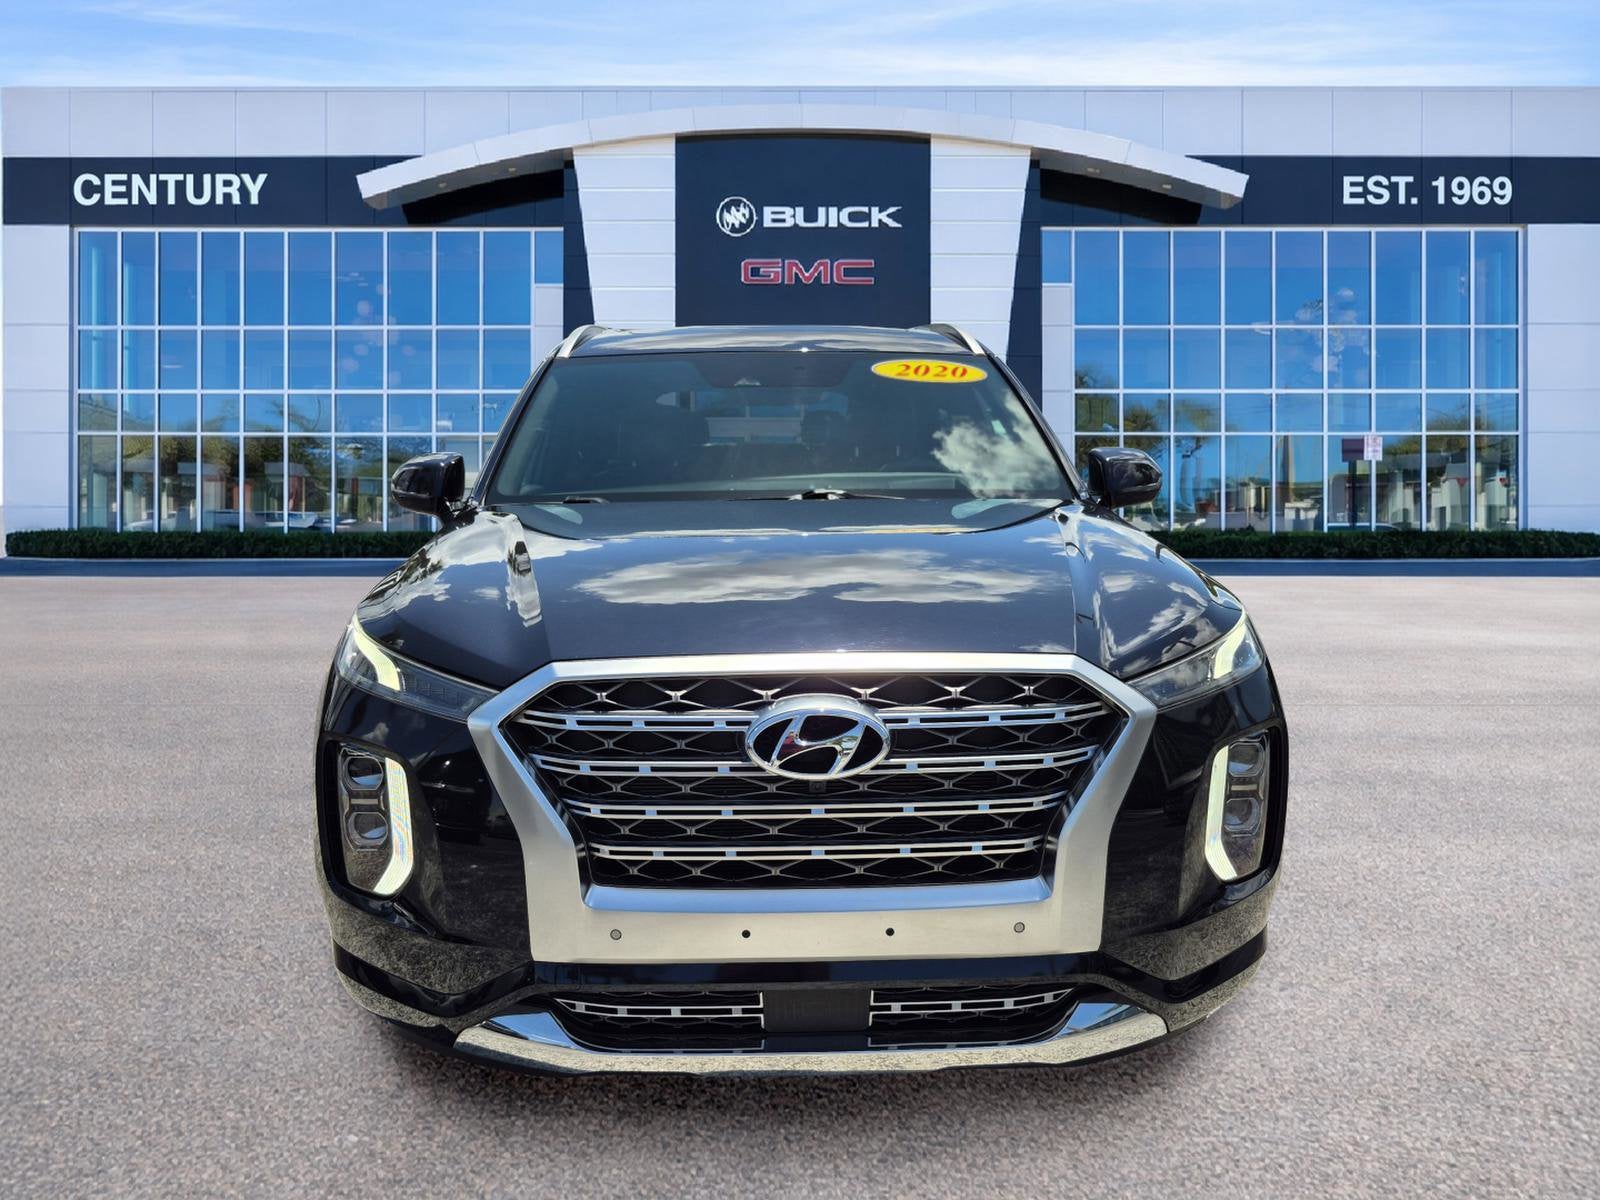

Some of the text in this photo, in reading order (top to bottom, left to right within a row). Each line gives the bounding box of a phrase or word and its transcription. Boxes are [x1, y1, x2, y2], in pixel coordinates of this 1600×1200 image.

[73, 172, 268, 206] CENTURY
[1342, 174, 1513, 206] EST. 1969
[762, 205, 903, 228] BUICK
[740, 258, 875, 285] GMC
[896, 363, 968, 378] 2020
